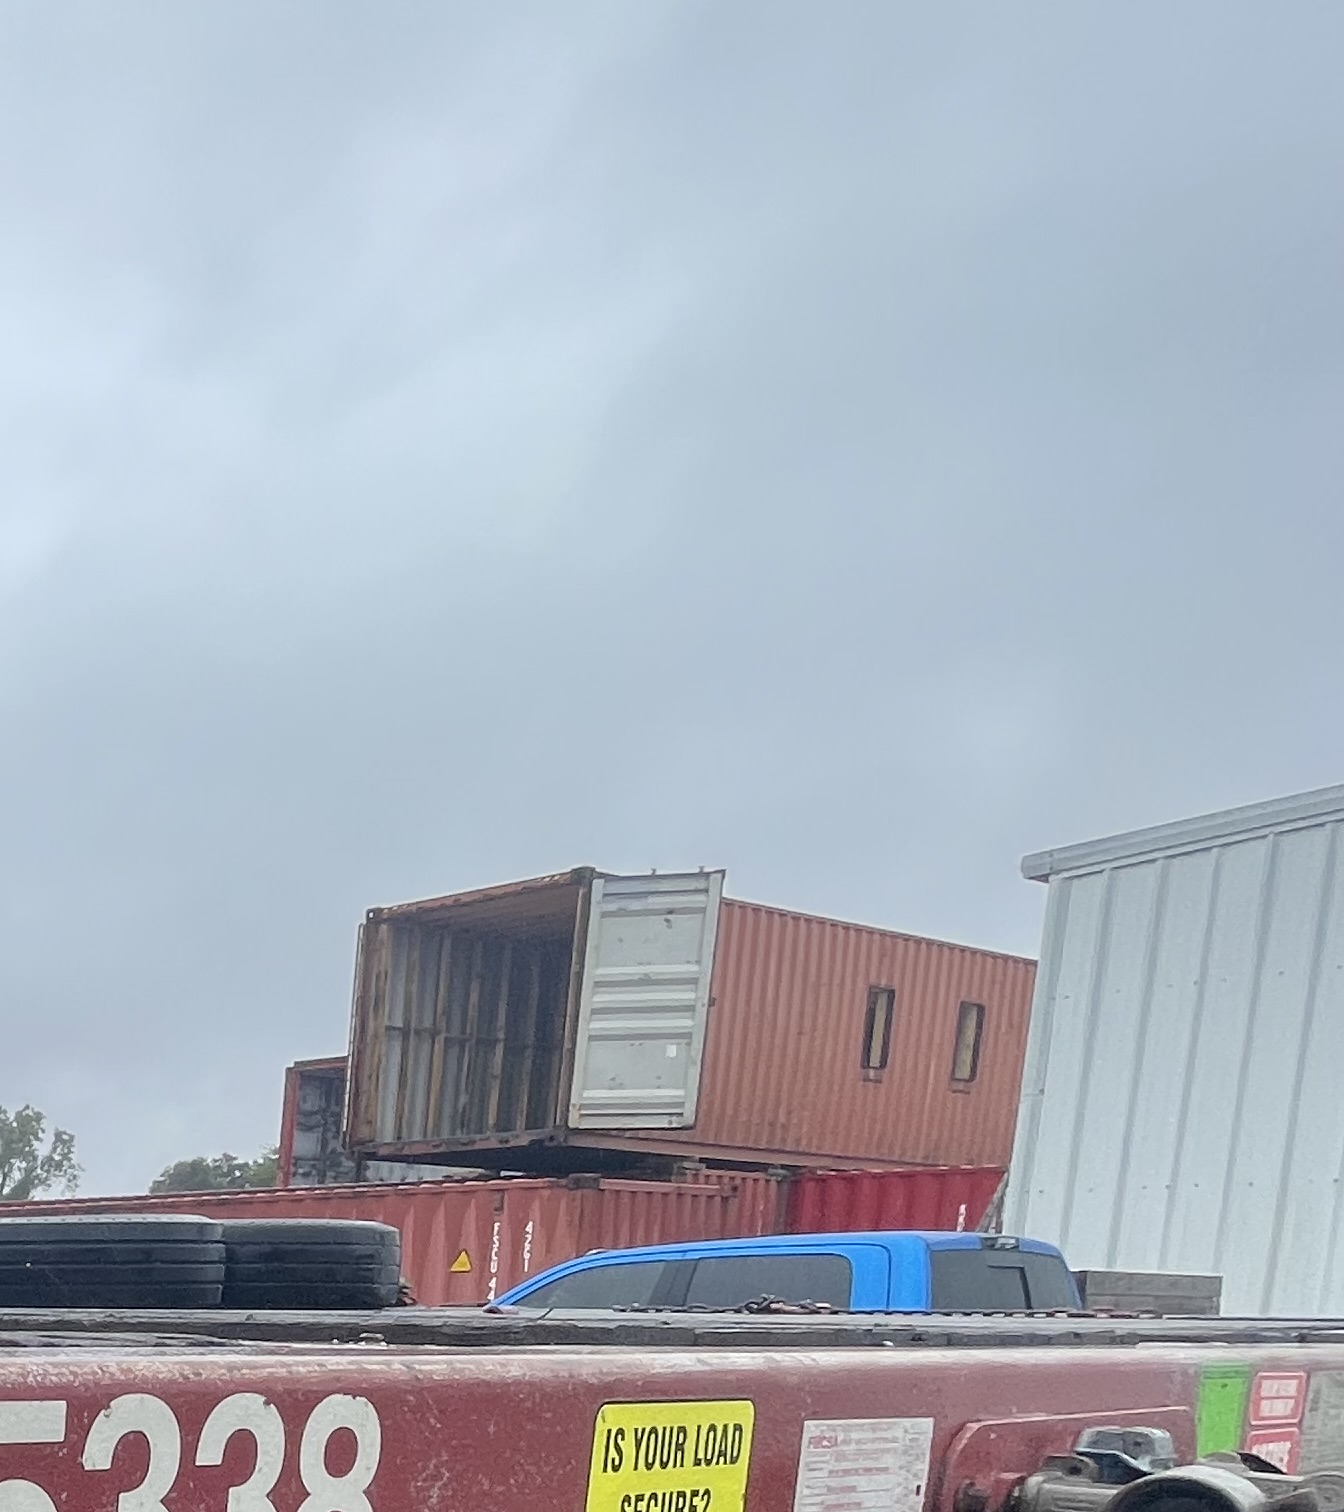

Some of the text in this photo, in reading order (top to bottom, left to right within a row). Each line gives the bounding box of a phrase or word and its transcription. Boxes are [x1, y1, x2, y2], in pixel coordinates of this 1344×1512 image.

[602, 1423, 743, 1474] IS YOUR LOAD
